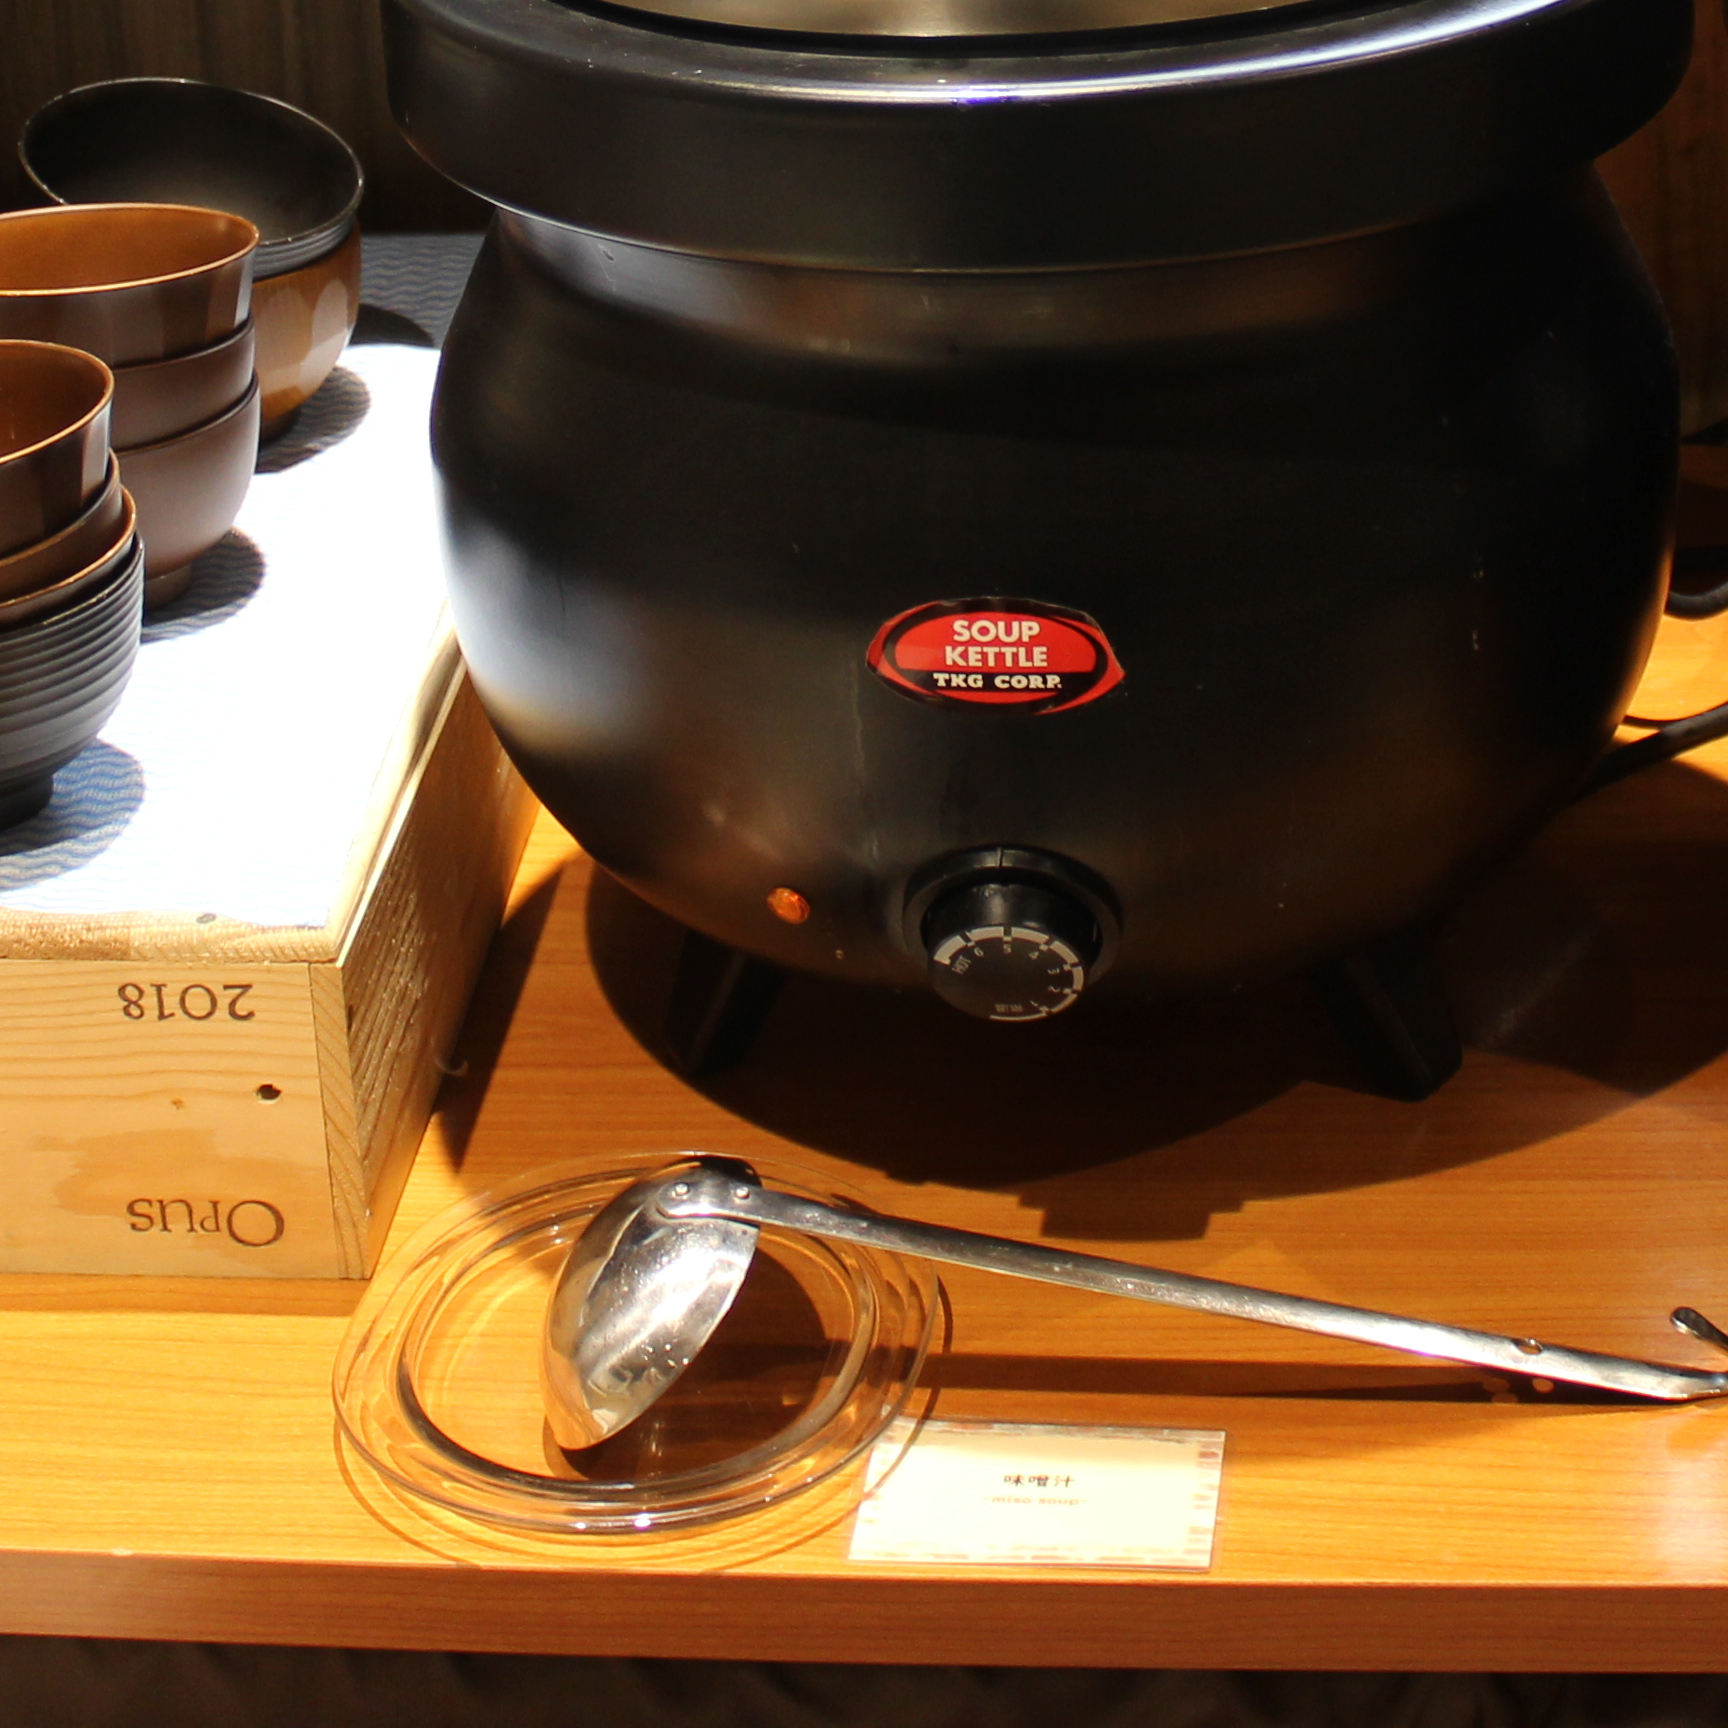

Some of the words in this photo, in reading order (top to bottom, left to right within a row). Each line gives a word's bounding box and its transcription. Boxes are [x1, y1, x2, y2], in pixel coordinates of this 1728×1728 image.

[951, 619, 1041, 644] SOUP
[944, 645, 1049, 669] KETTLE
[933, 672, 985, 689] TKG
[993, 673, 1063, 690] CORP.
[973, 947, 985, 958] 6
[1003, 944, 1012, 955] 5
[117, 982, 255, 1022] 2018
[1003, 1474, 1077, 1489] 味噌汁
